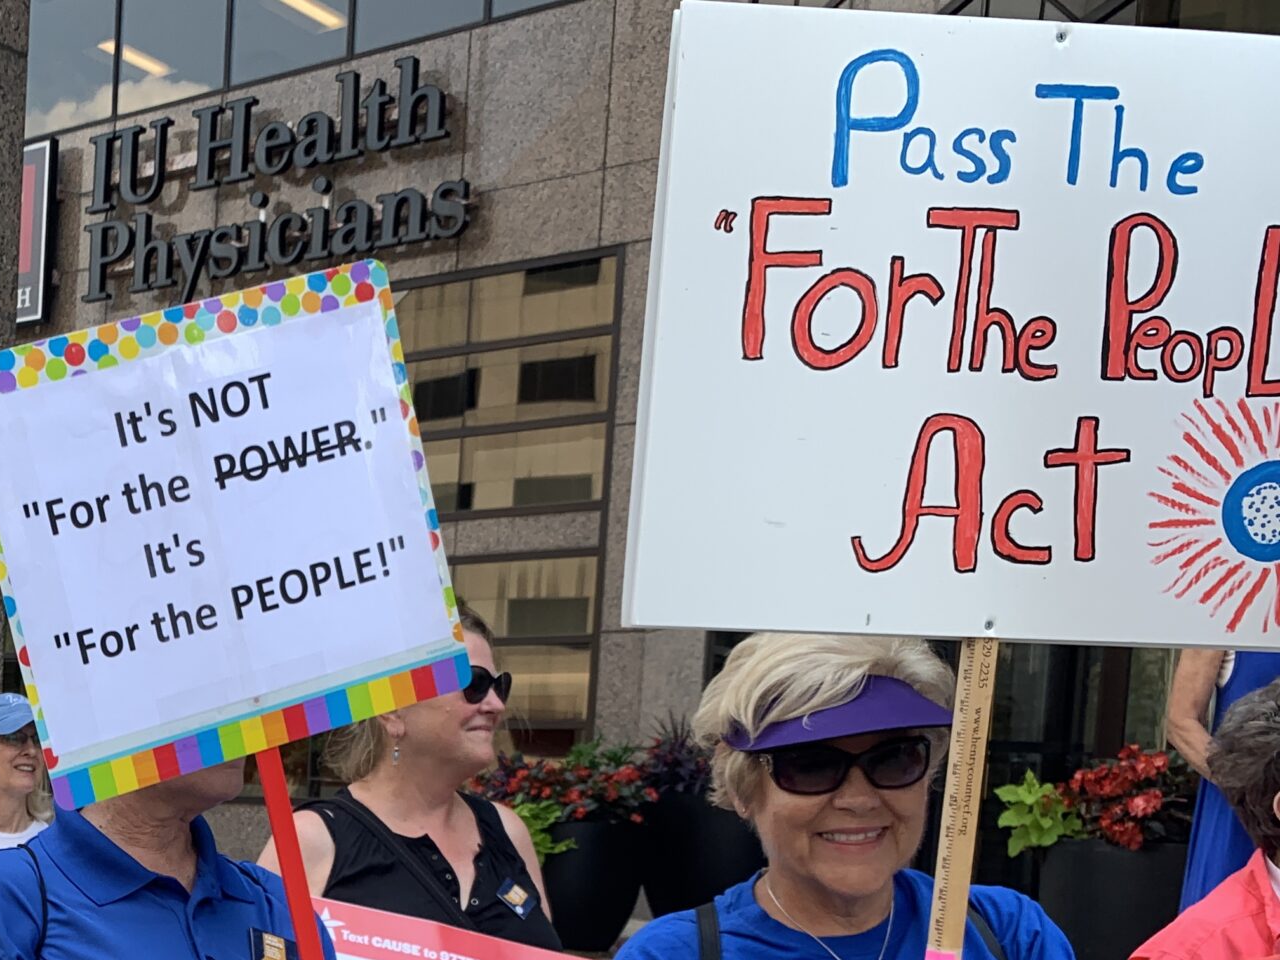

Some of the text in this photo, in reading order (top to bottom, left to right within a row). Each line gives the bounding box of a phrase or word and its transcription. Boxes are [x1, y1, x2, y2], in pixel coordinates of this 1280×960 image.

[85, 56, 450, 214] IU Health
[831, 49, 1205, 195] Pass The
[82, 178, 471, 301] Physicians
[926, 207, 1058, 381] The
[114, 373, 272, 448] It's NOT
[22, 494, 110, 536] "For
[121, 474, 191, 515] the
[143, 534, 206, 579] It's
[851, 413, 1131, 574] Act
[53, 536, 406, 666] "For the PEOPLE!"
[957, 707, 983, 836] www.henrycountycf.org
[341, 929, 370, 945] Text
[371, 936, 421, 956] CAUSE
[423, 948, 438, 960] to
